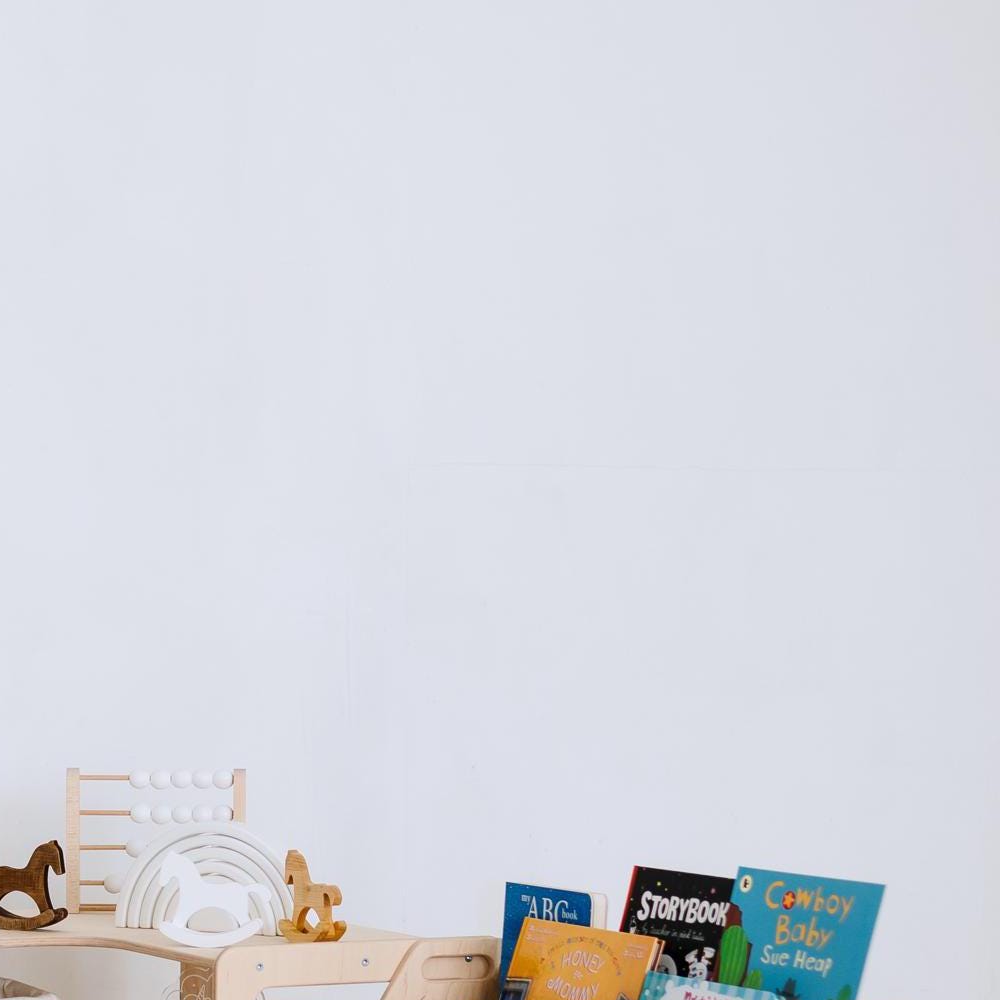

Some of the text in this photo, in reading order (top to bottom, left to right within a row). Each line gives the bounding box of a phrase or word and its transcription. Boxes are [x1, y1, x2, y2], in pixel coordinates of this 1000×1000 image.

[528, 895, 569, 922] ABC
[562, 909, 578, 920] book
[636, 890, 731, 927] STORYBOOK
[764, 880, 855, 923] Cowboy
[775, 914, 834, 951] Baby
[760, 944, 833, 978] Sue Heap
